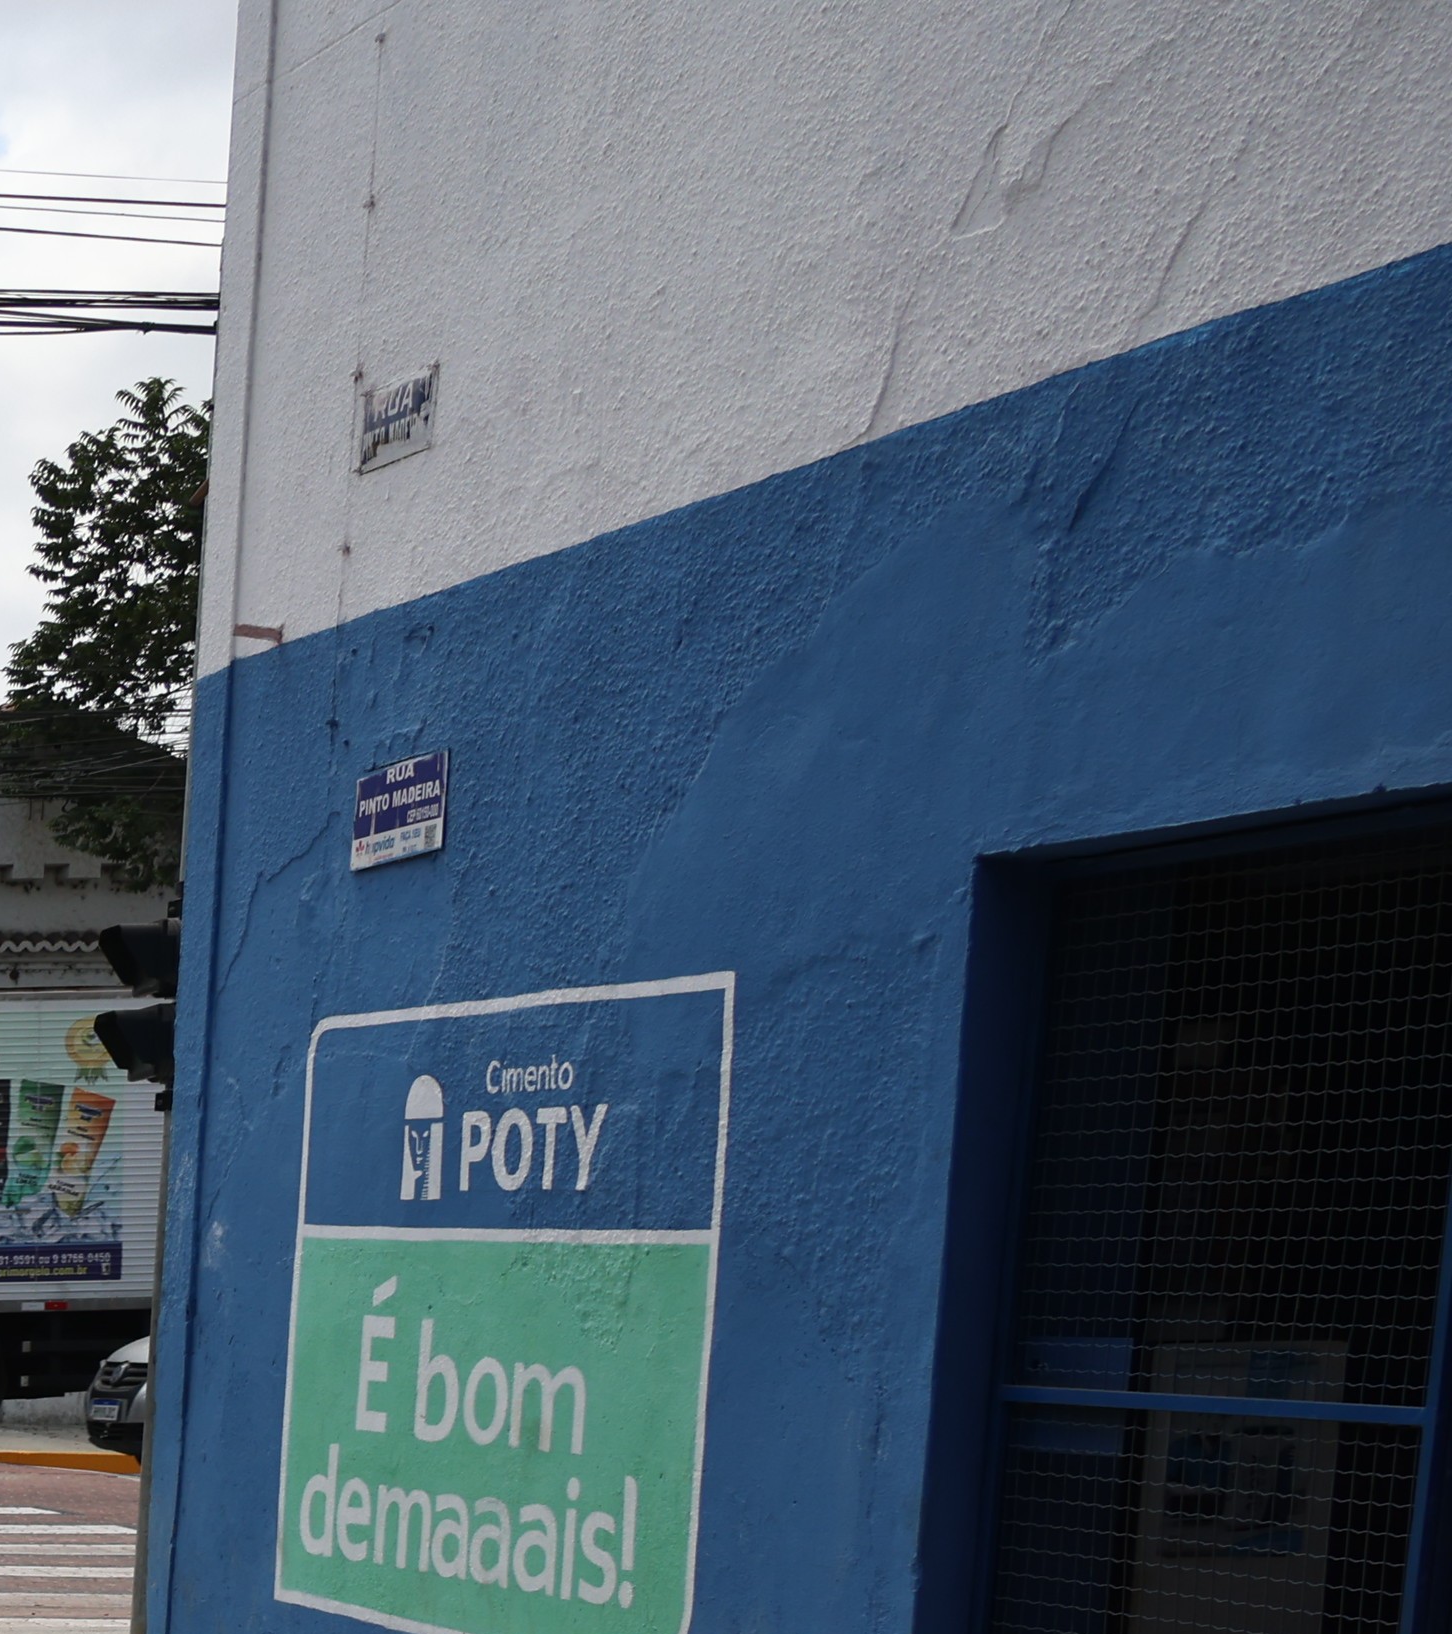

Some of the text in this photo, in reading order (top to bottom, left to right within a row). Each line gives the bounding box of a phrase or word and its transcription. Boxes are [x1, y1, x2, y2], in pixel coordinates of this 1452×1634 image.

[386, 762, 414, 785] RUA
[359, 779, 441, 818] PINTO MADEIRA
[486, 1055, 573, 1095] Cimento
[459, 1104, 608, 1192] POTY
[39, 1257, 50, 1265] ou
[52, 1254, 59, 1264] 9
[355, 1276, 586, 1455] É bom
[299, 1444, 637, 1609] demaaais!
